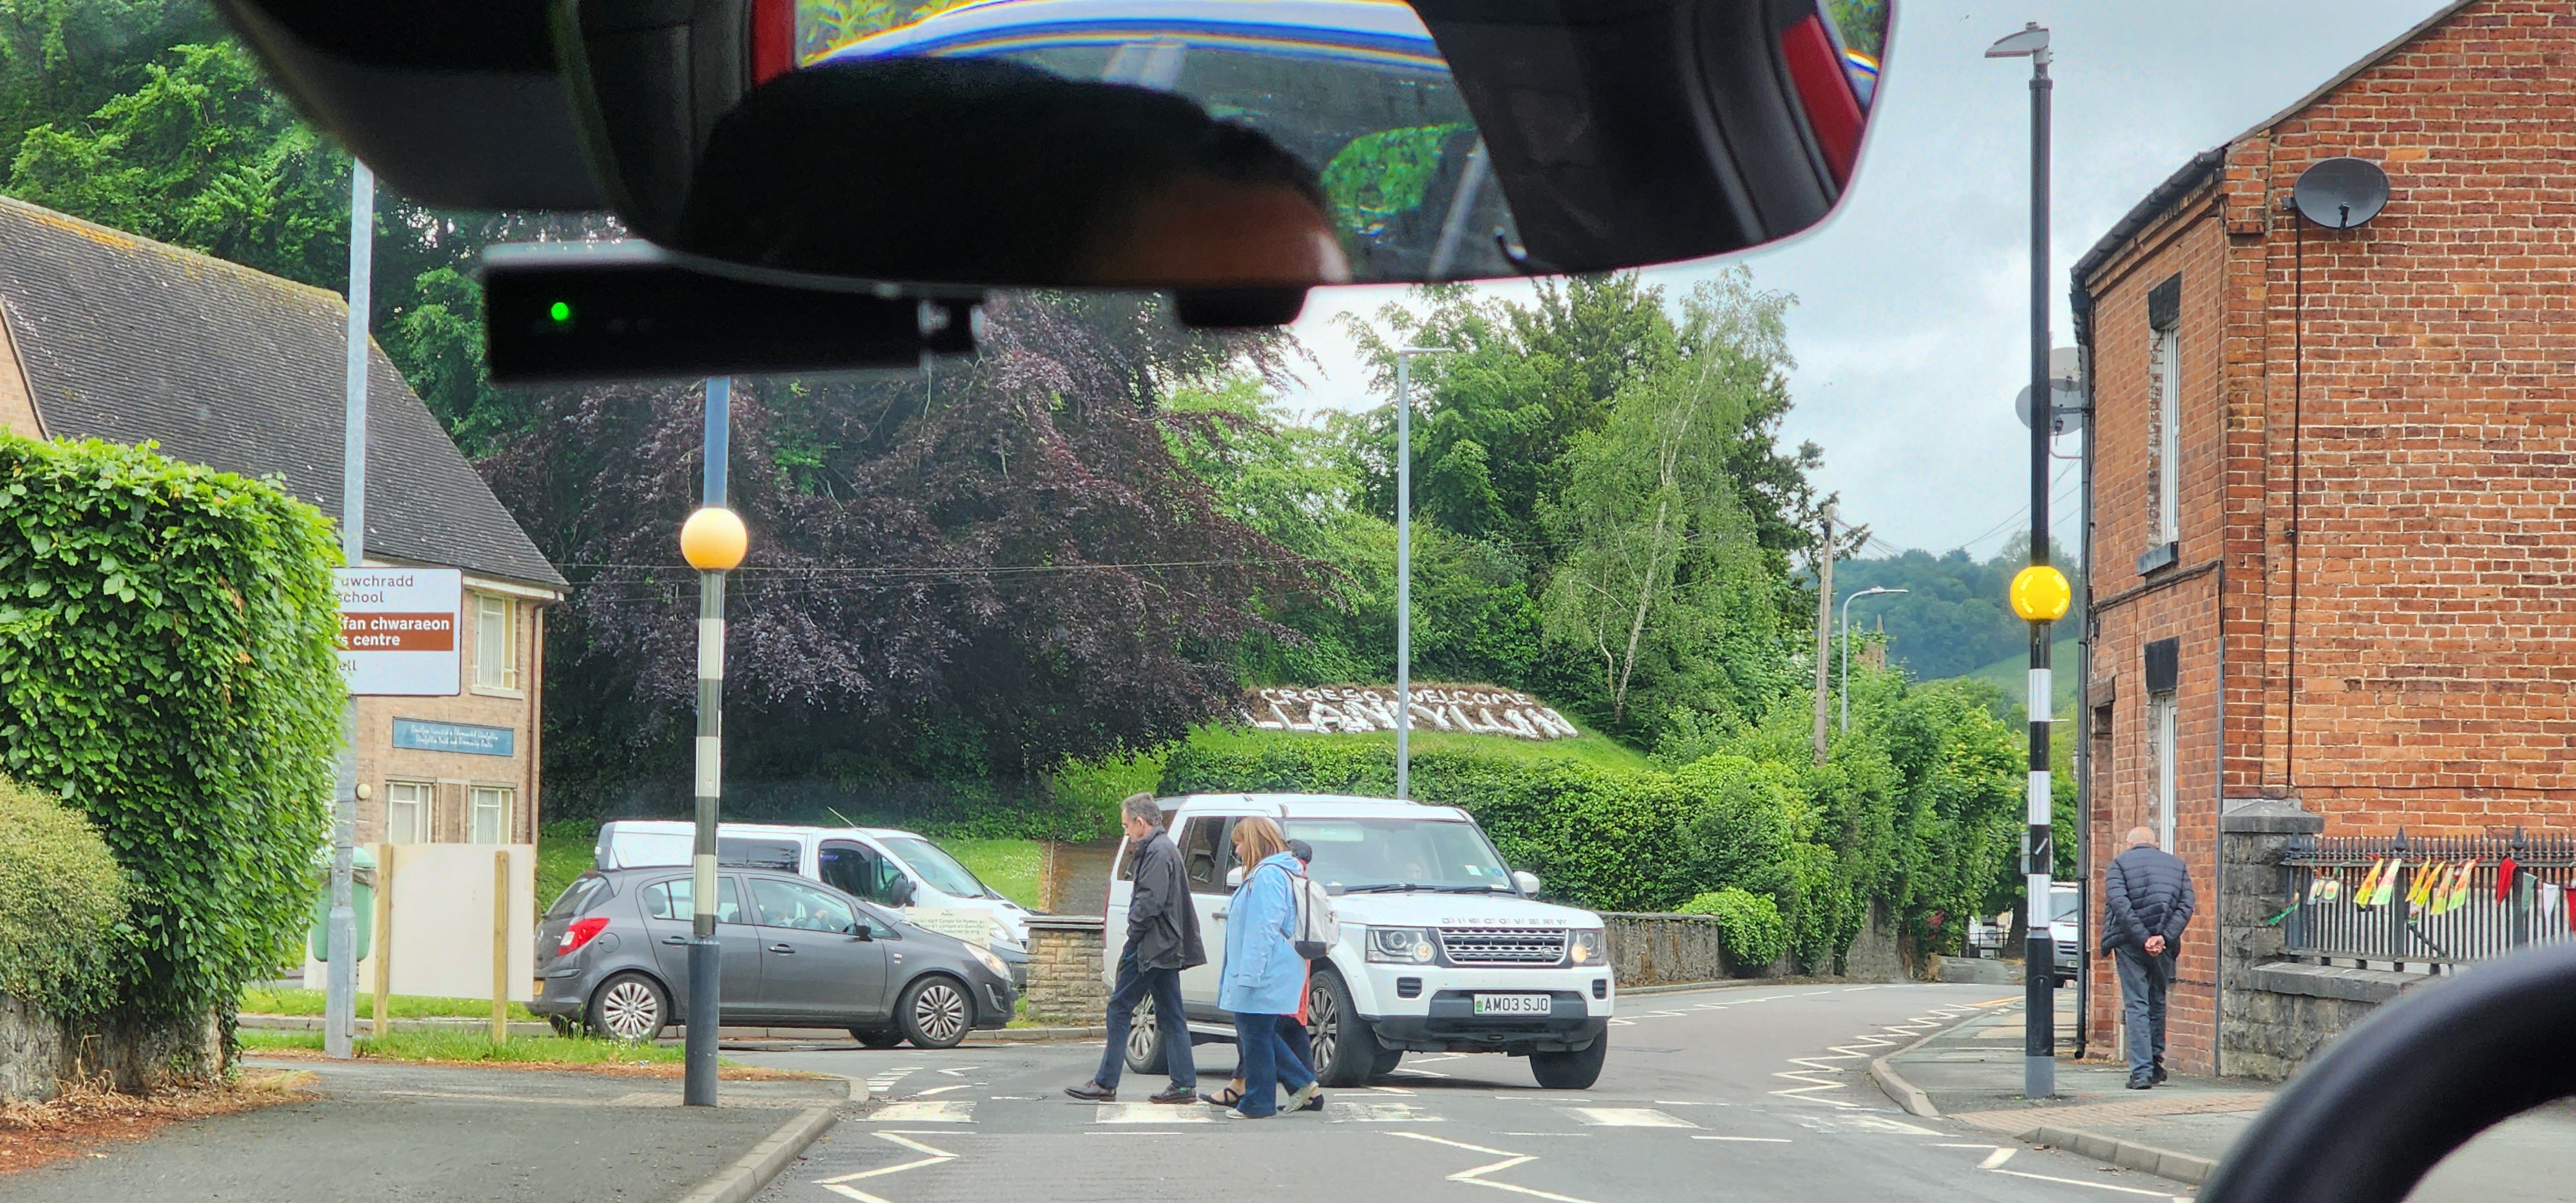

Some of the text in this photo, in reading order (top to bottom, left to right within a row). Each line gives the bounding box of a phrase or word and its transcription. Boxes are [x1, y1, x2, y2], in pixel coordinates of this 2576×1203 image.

[370, 616, 450, 630] chwaraeon
[353, 633, 401, 646] centre
[1260, 688, 1533, 706] CROESO WELCOME
[1242, 701, 1578, 739] LLANFYLLIN
[1484, 998, 1519, 1011] AM03
[1524, 998, 1548, 1011] SJO
